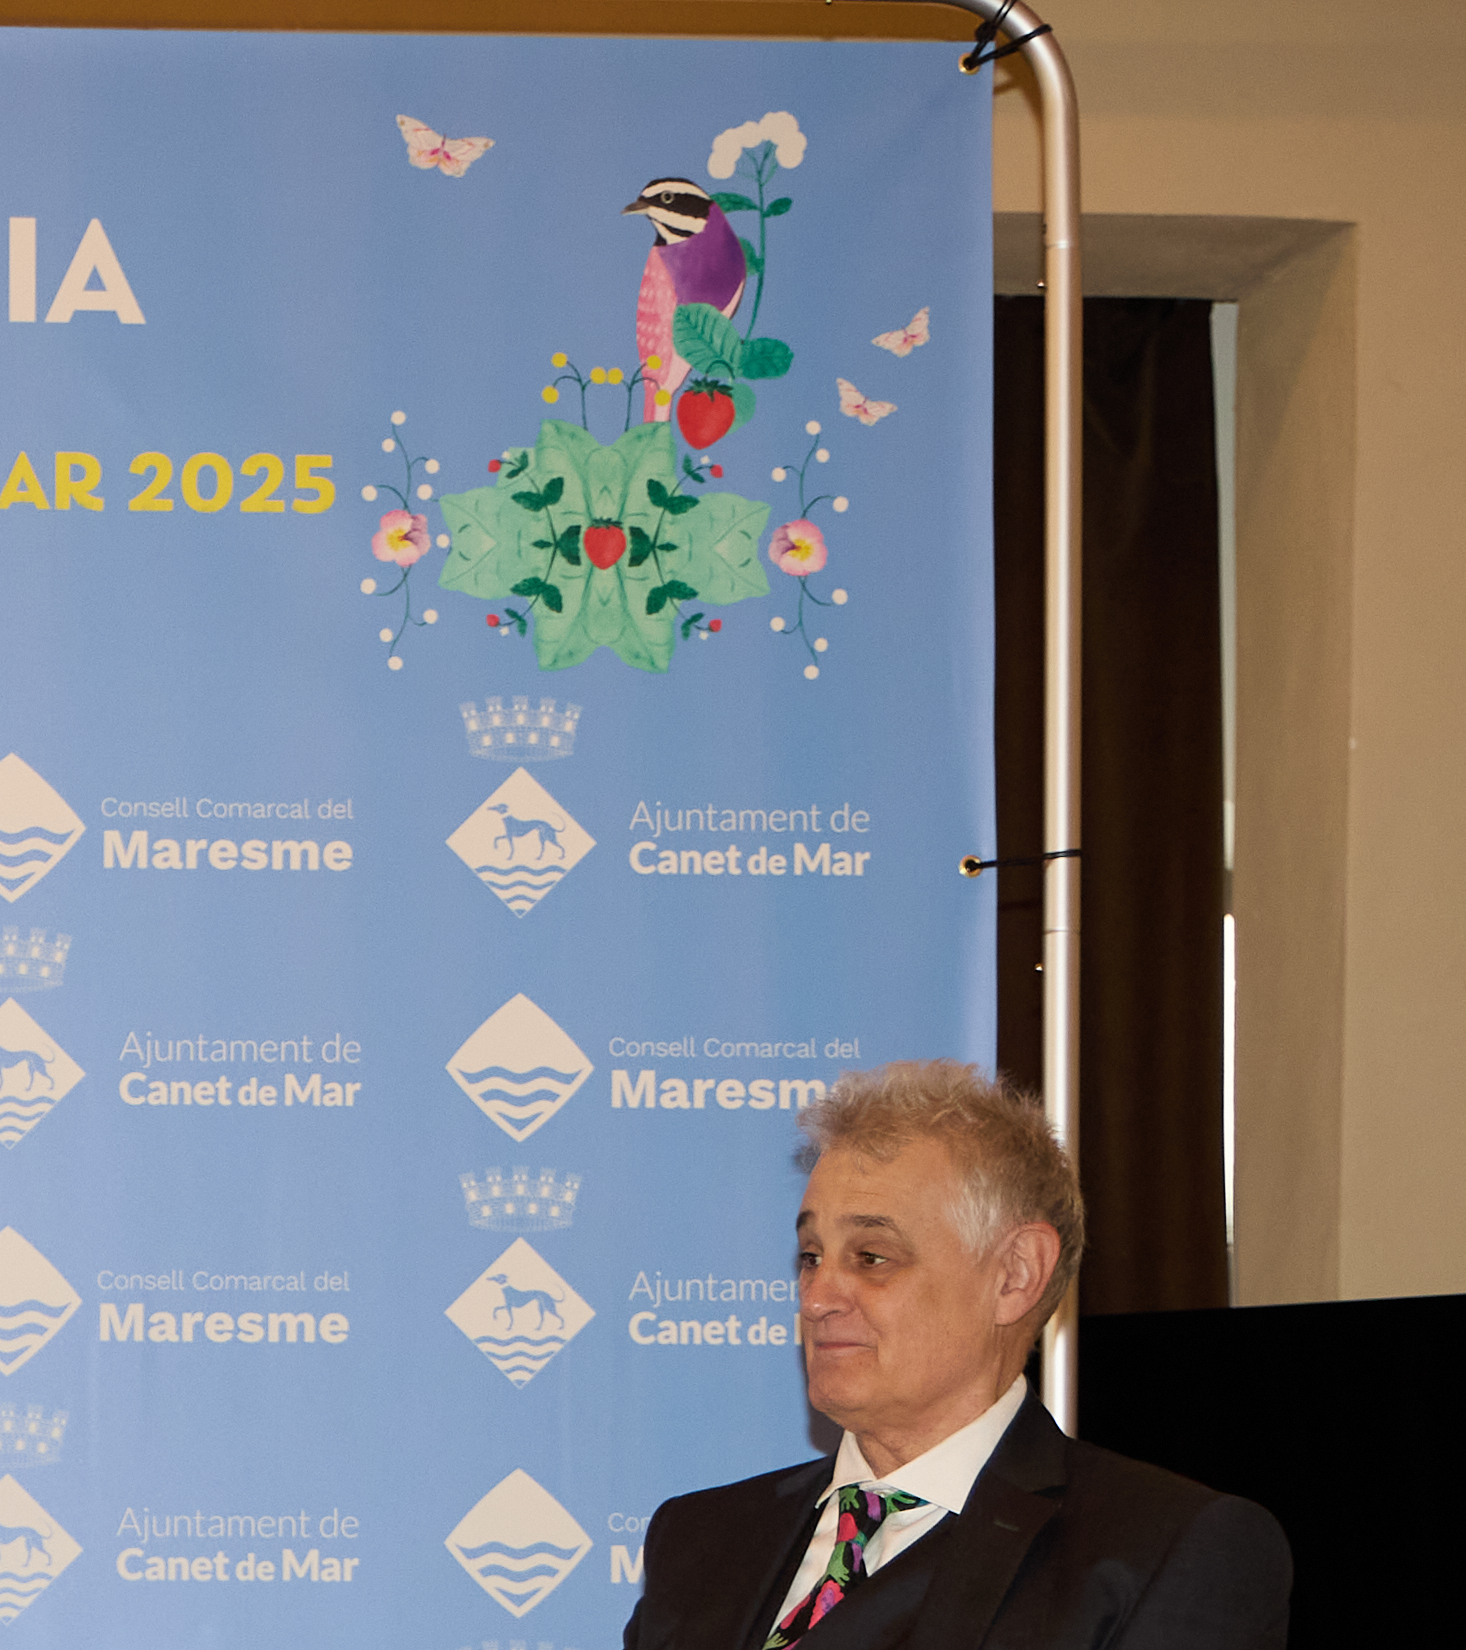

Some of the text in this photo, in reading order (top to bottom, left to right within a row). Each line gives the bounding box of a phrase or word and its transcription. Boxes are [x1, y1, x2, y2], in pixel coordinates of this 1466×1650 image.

[129, 452, 335, 515] 2025
[100, 796, 354, 820] Consell Comarcal del
[629, 800, 870, 838] Ajuntament de
[103, 829, 353, 871] Maresme
[629, 840, 871, 876] Canet de Mar
[96, 1269, 350, 1292] Consell Comarcal del
[99, 1302, 350, 1344] Maresme
